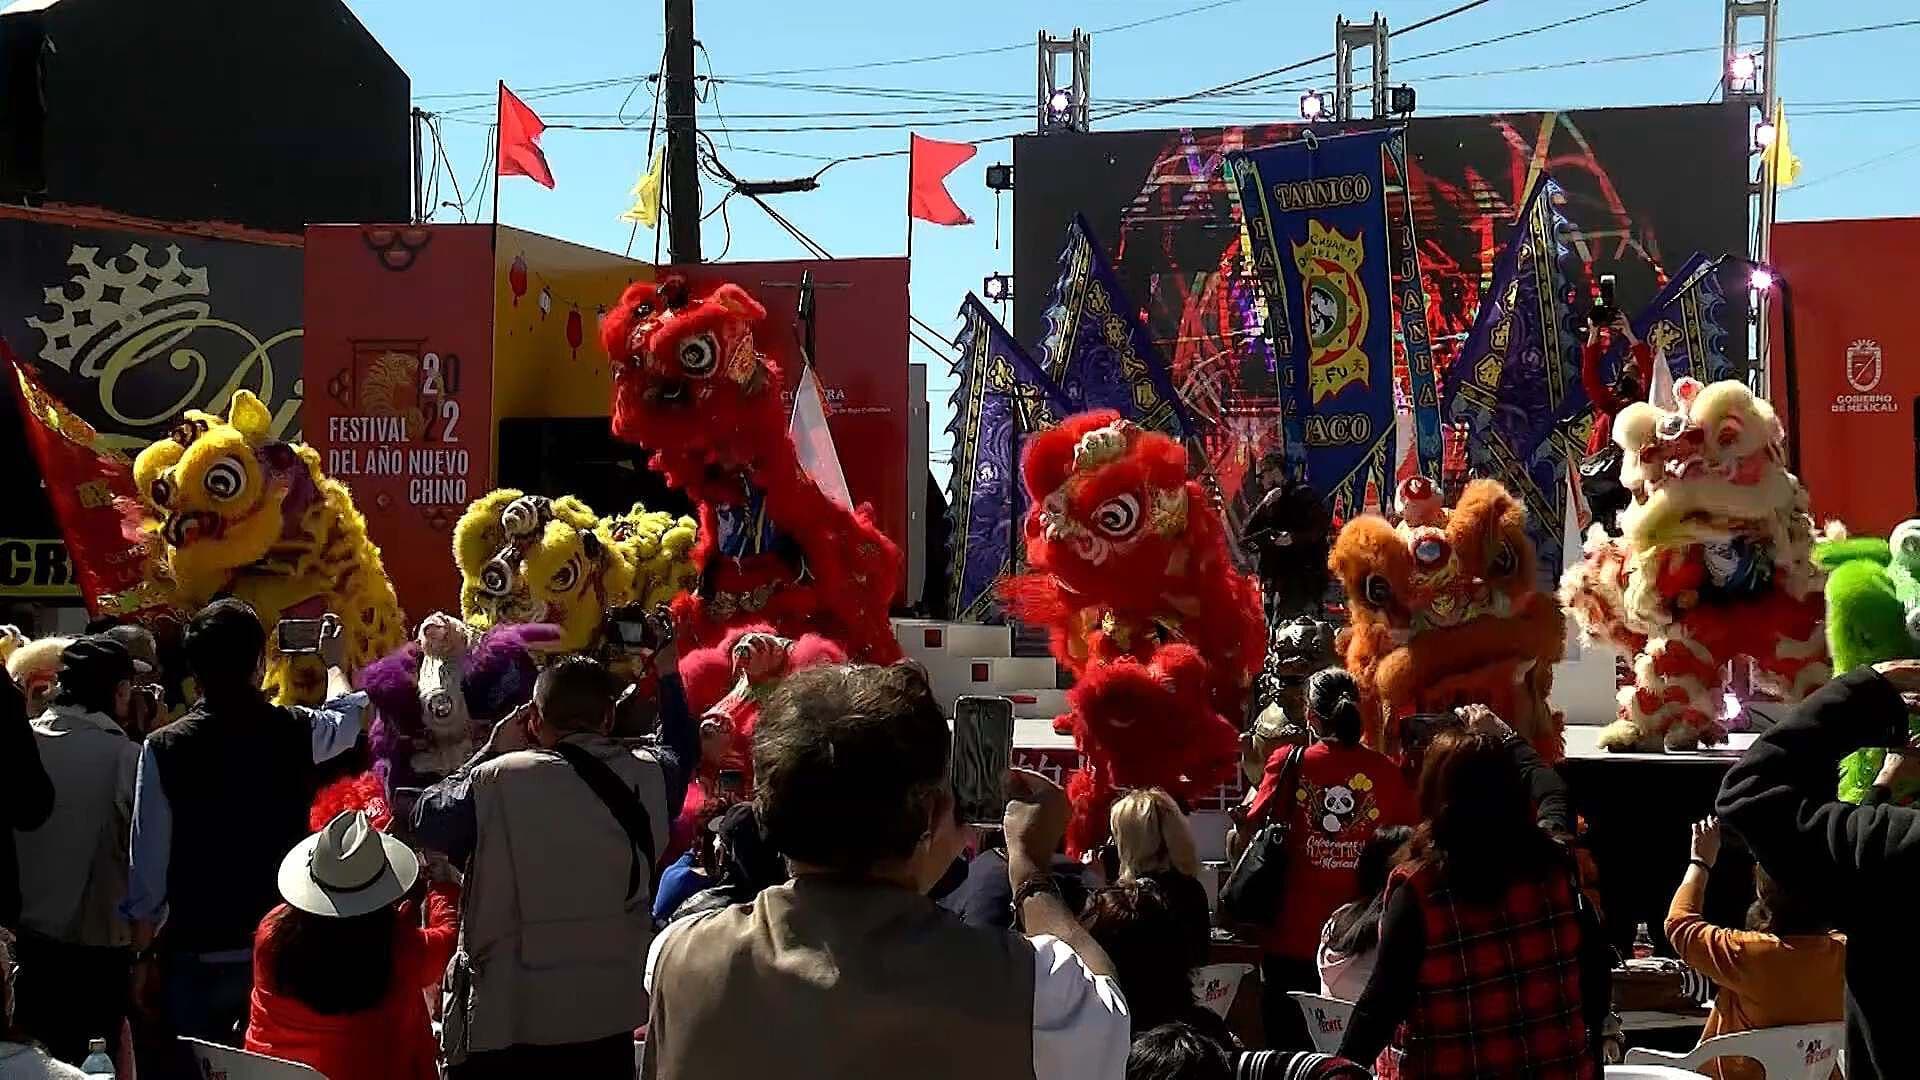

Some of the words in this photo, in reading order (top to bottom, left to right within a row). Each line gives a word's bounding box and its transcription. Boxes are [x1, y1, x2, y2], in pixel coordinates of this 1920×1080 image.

[329, 417, 411, 442] FESTIVAL
[329, 449, 361, 475] DEL
[365, 445, 402, 475] AÑO
[408, 450, 469, 476] NUEVO
[409, 479, 467, 504] CHINO
